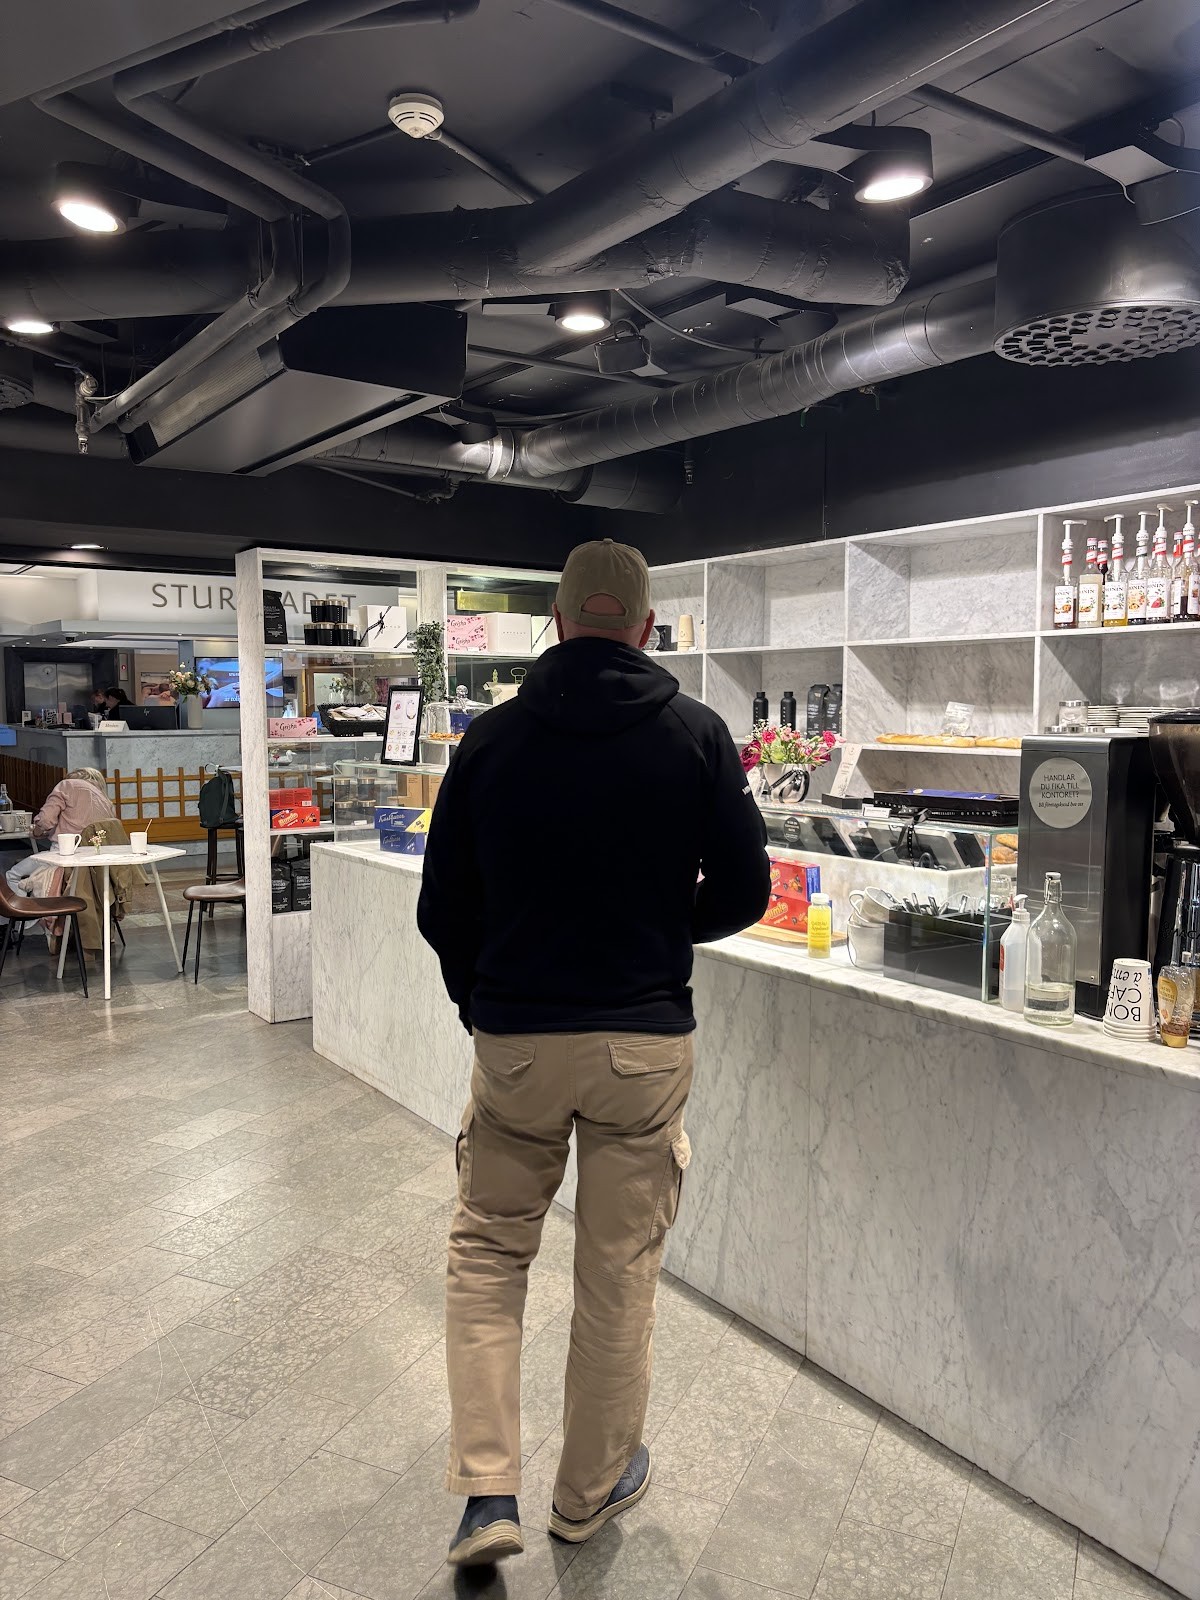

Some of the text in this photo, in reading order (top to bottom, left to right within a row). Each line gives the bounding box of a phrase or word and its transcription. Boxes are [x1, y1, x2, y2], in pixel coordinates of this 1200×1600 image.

[1043, 773, 1076, 781] HANDLAR
[1052, 782, 1066, 790] FIKA
[1107, 985, 1142, 1004] CAF
[1105, 1002, 1141, 1021] BON
